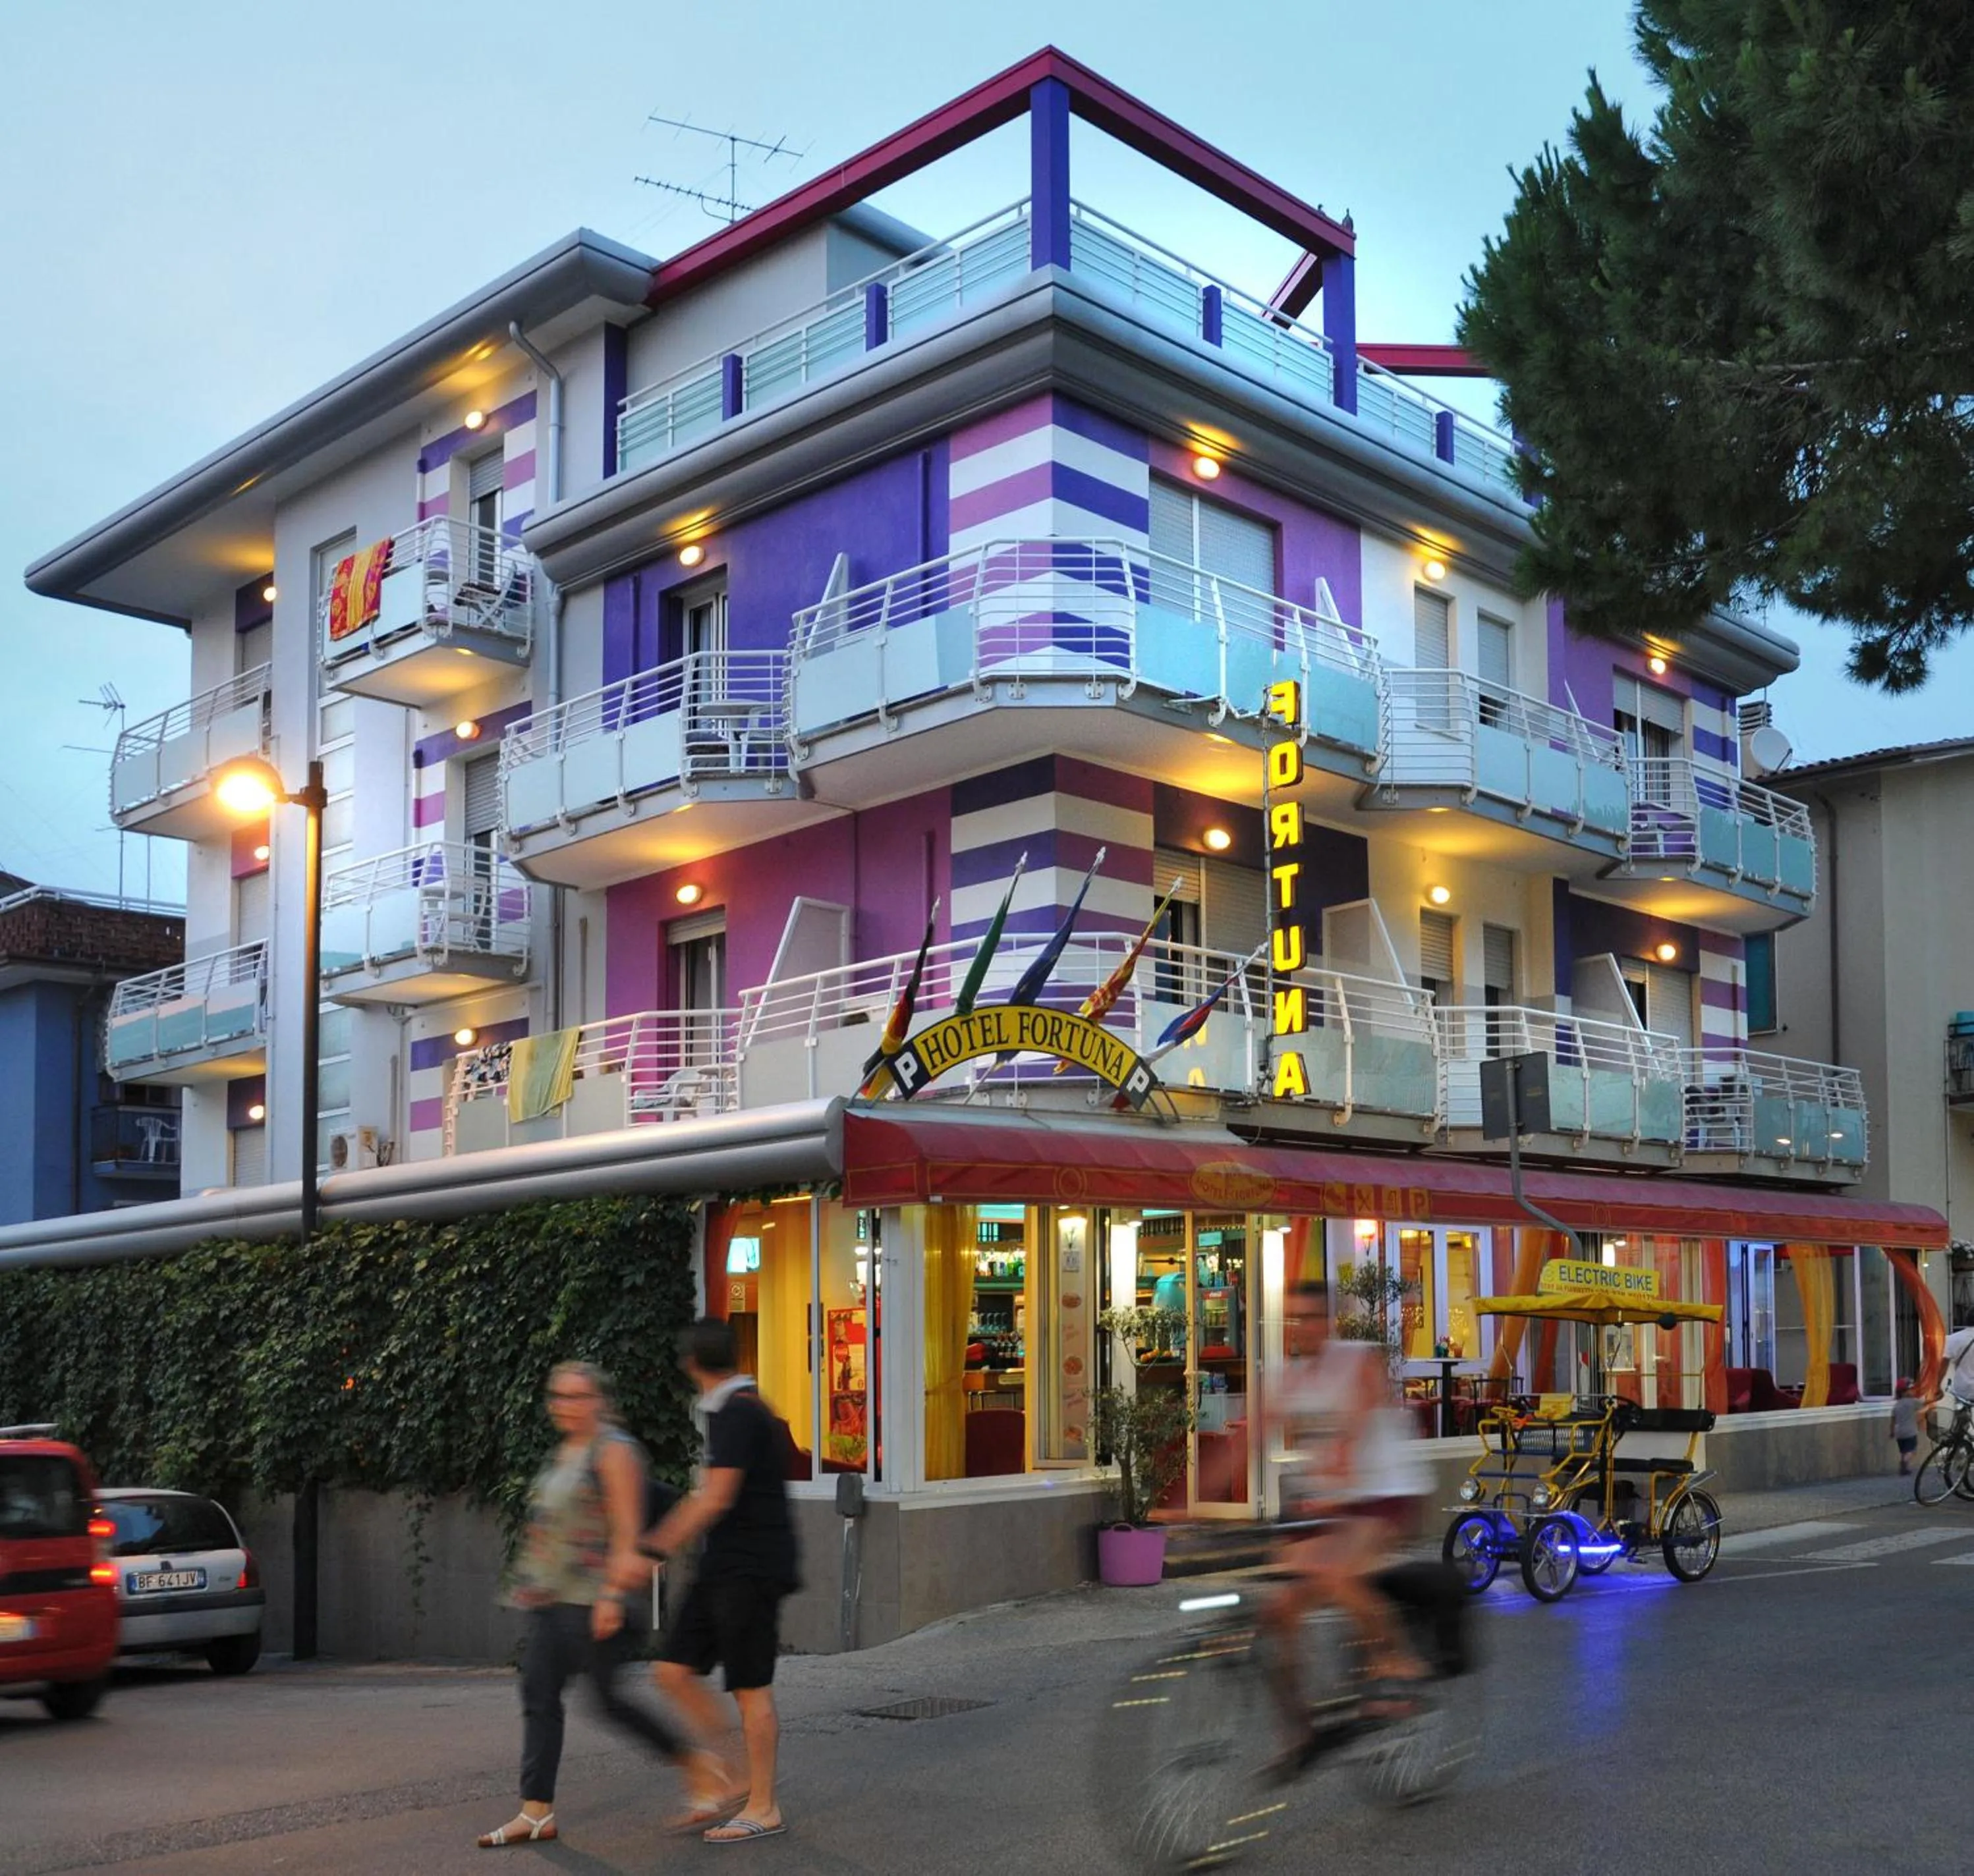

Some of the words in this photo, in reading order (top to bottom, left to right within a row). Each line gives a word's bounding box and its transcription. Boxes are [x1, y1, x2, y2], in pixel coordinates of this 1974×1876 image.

[921, 1012, 1009, 1070] HOTEL
[1018, 1012, 1124, 1081] FORTUNA
[894, 1051, 918, 1090] P
[1126, 1065, 1150, 1093] P
[1559, 1265, 1621, 1287] ELECTRIC
[1624, 1273, 1652, 1291] BIKE
[138, 1576, 154, 1589] BF
